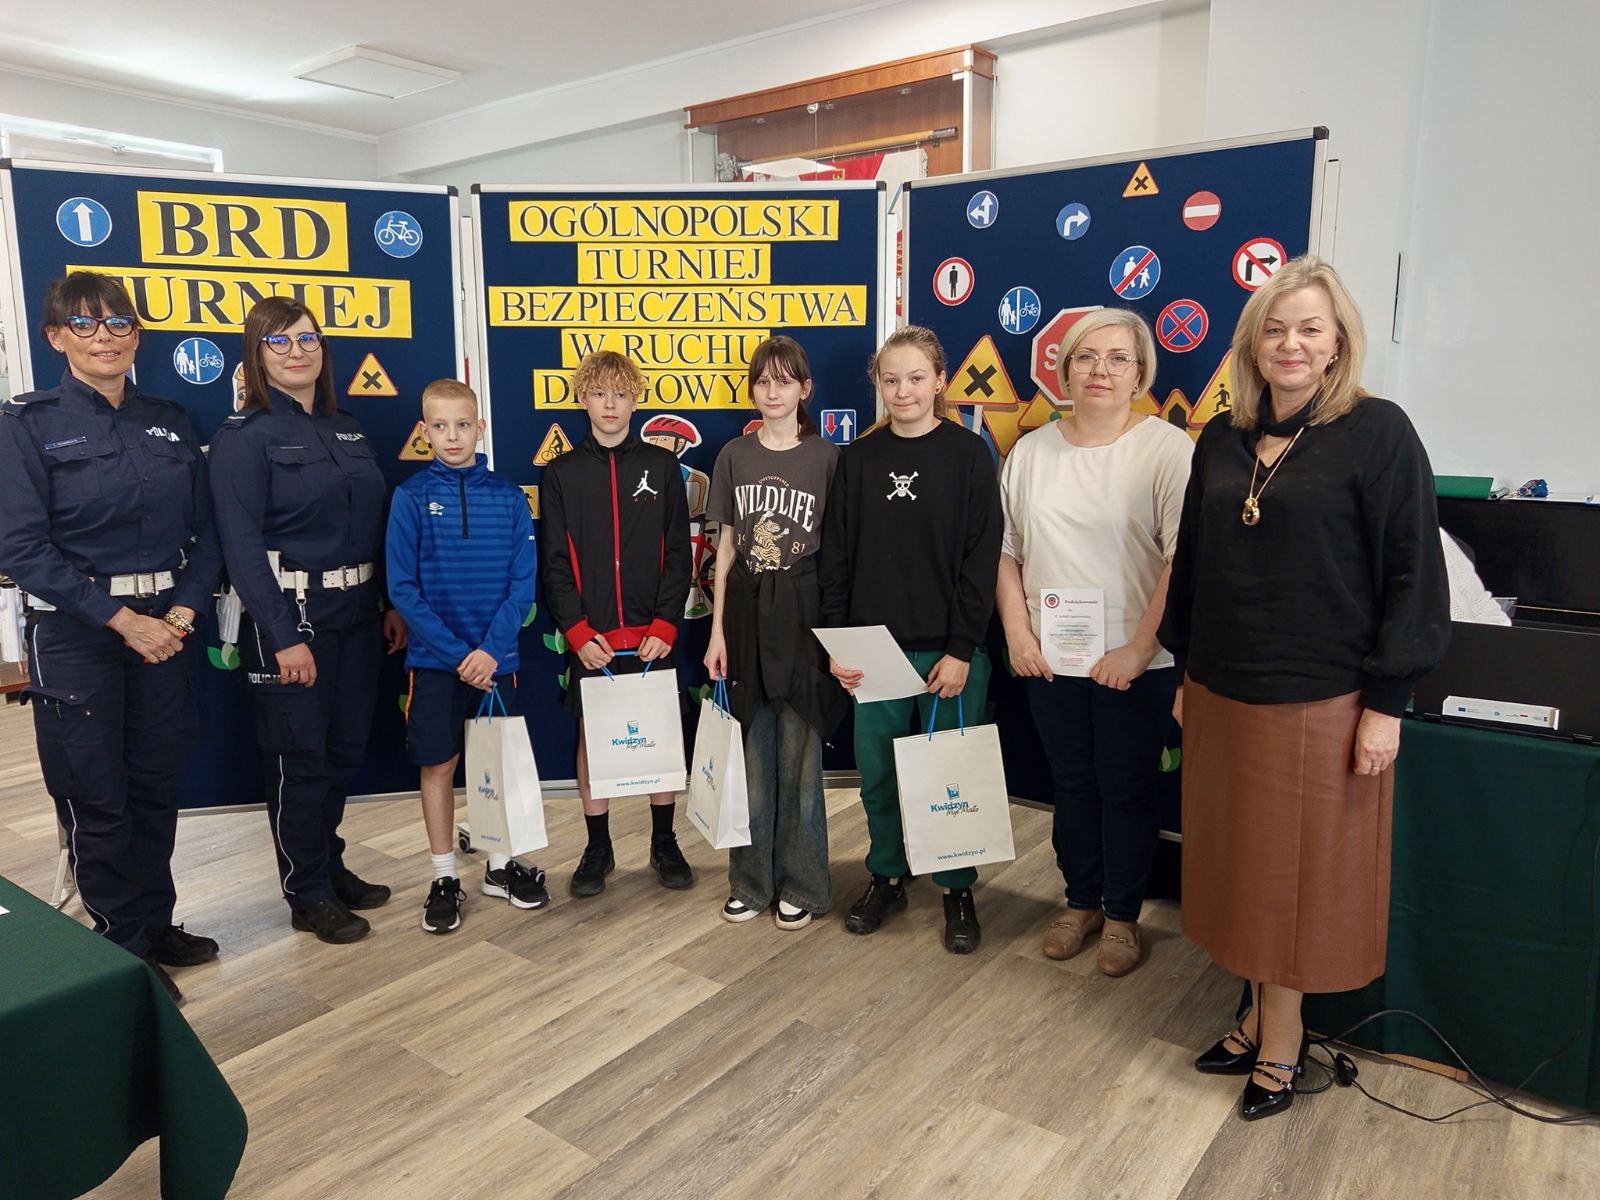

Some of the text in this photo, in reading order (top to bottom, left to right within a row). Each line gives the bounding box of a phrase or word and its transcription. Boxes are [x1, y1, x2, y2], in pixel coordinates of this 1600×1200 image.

[152, 201, 330, 260] BRD
[519, 203, 833, 238] OGÓLNOPOLSKI
[586, 248, 763, 280] TURNIEJ
[106, 275, 395, 329] URNEJ
[500, 288, 862, 323] BEZPIECZEŃSTWA
[622, 333, 764, 365] RUCHU
[735, 484, 815, 533] WILDLIFE
[612, 737, 646, 746] Kwidzyn
[931, 801, 969, 813] Kwidzyn
